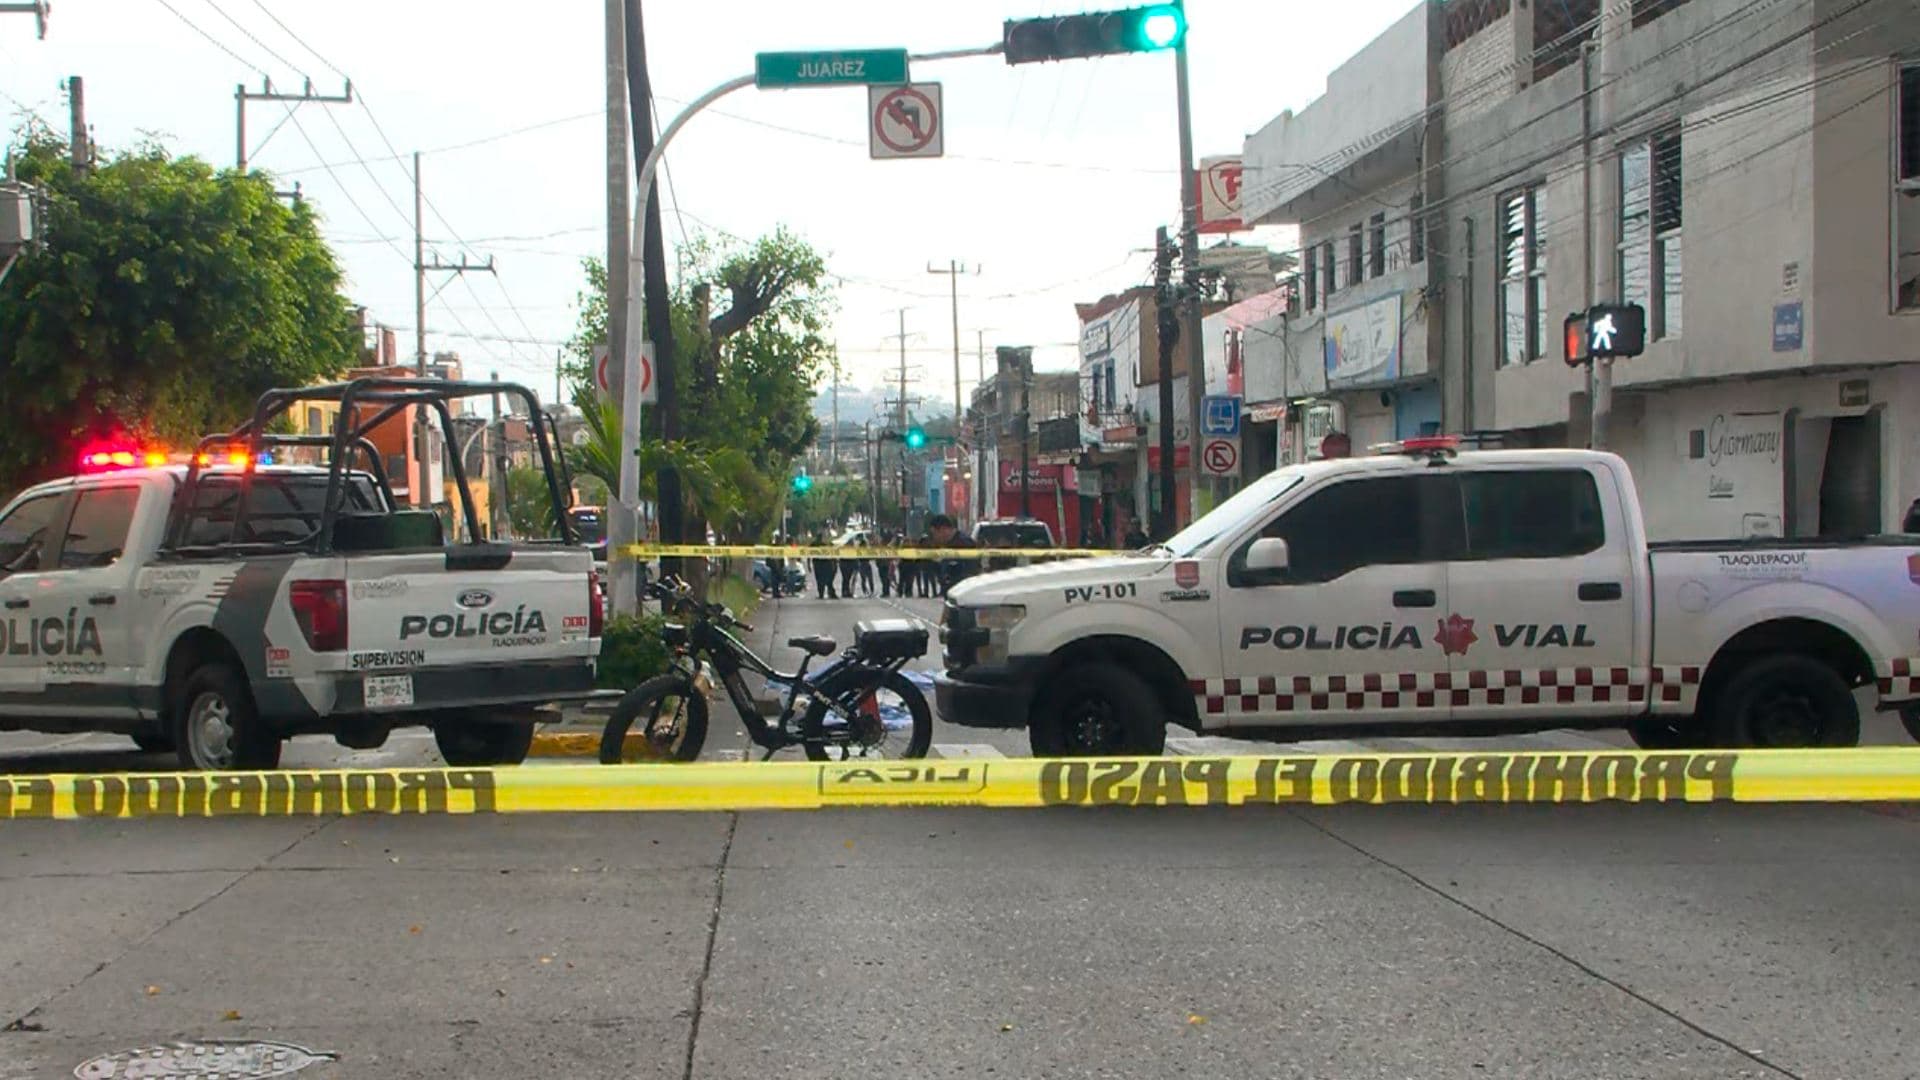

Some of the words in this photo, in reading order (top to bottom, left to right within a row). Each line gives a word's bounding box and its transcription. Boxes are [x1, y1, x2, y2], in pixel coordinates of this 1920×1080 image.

[798, 61, 865, 77] JUAREZ
[1064, 583, 1137, 604] PV-101
[0, 607, 103, 656] LICÍA
[400, 604, 547, 640] POLICÍA
[1239, 622, 1423, 650] POLICÍA
[1494, 624, 1596, 648] VIAL
[352, 650, 424, 668] SUPERVISION
